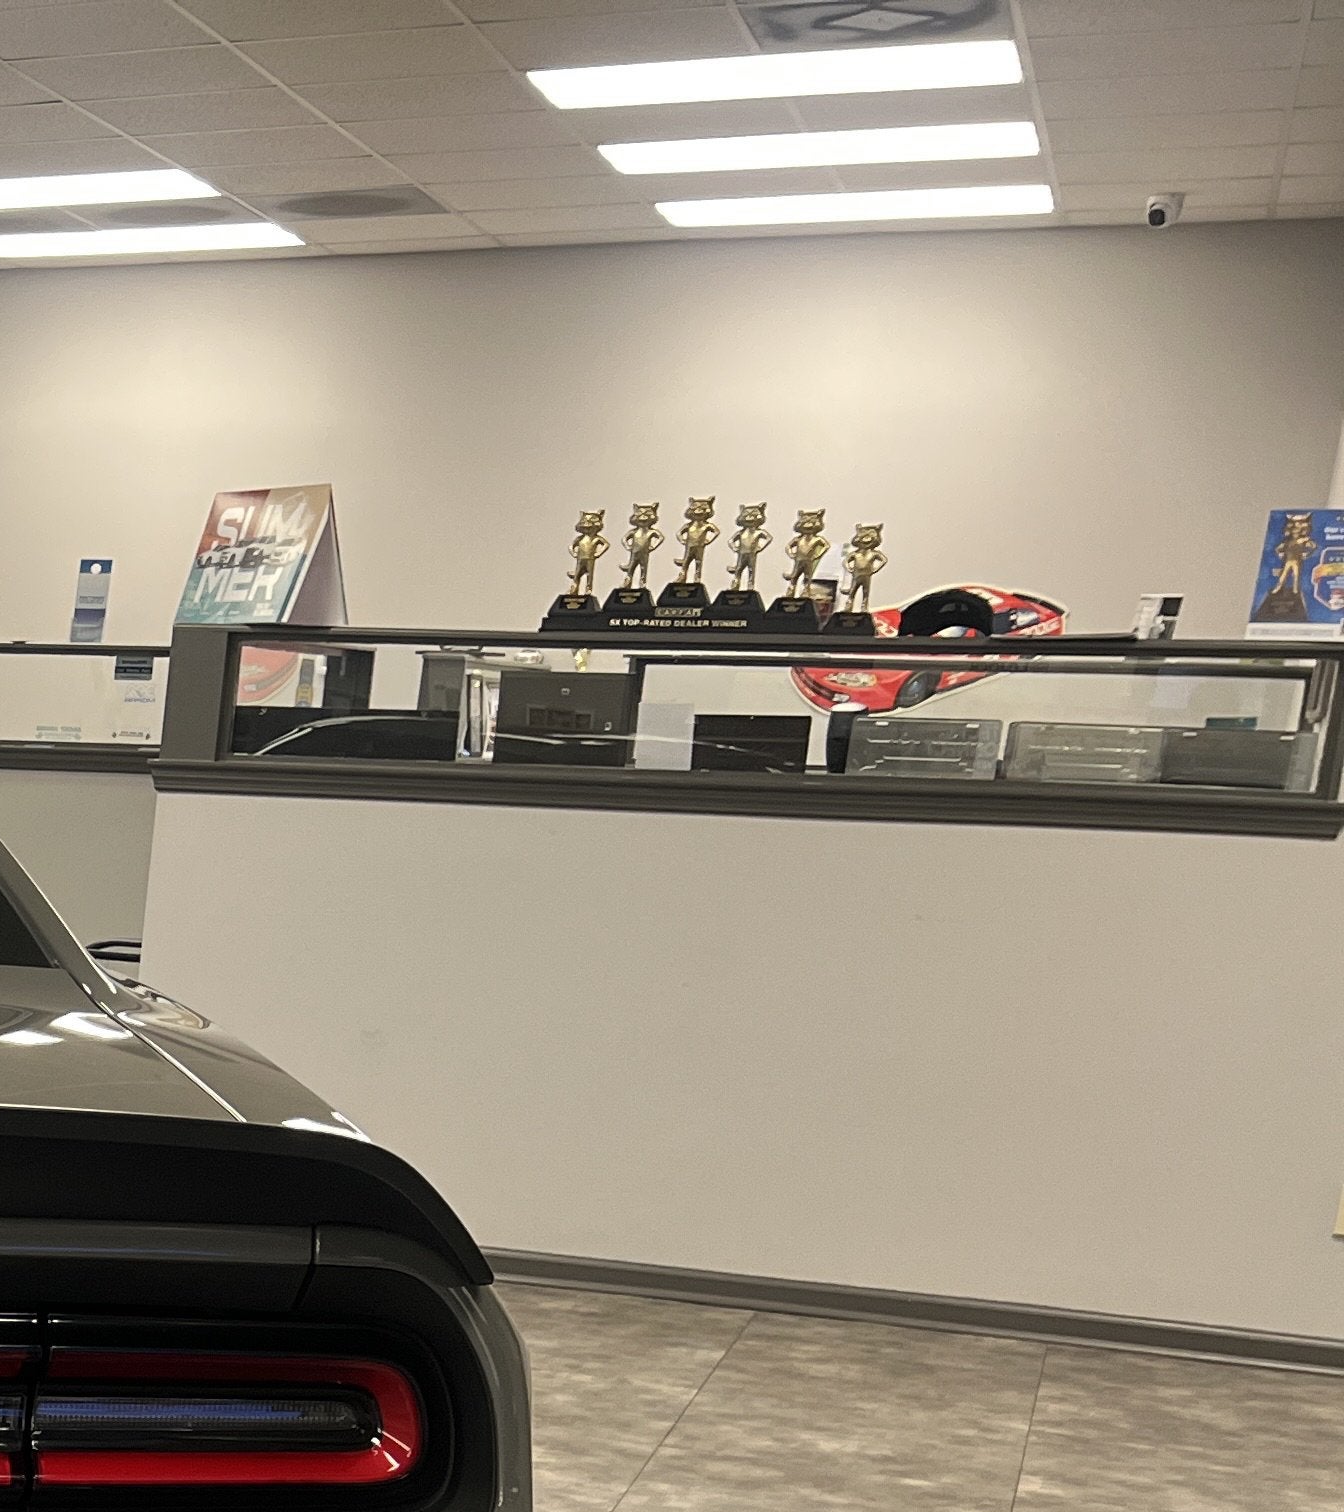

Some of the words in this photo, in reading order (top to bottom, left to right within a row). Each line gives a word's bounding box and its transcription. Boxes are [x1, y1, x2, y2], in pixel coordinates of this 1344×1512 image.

[623, 619, 672, 628] TOP-RATED
[673, 619, 710, 628] DEALER
[712, 619, 748, 628] WINNER
